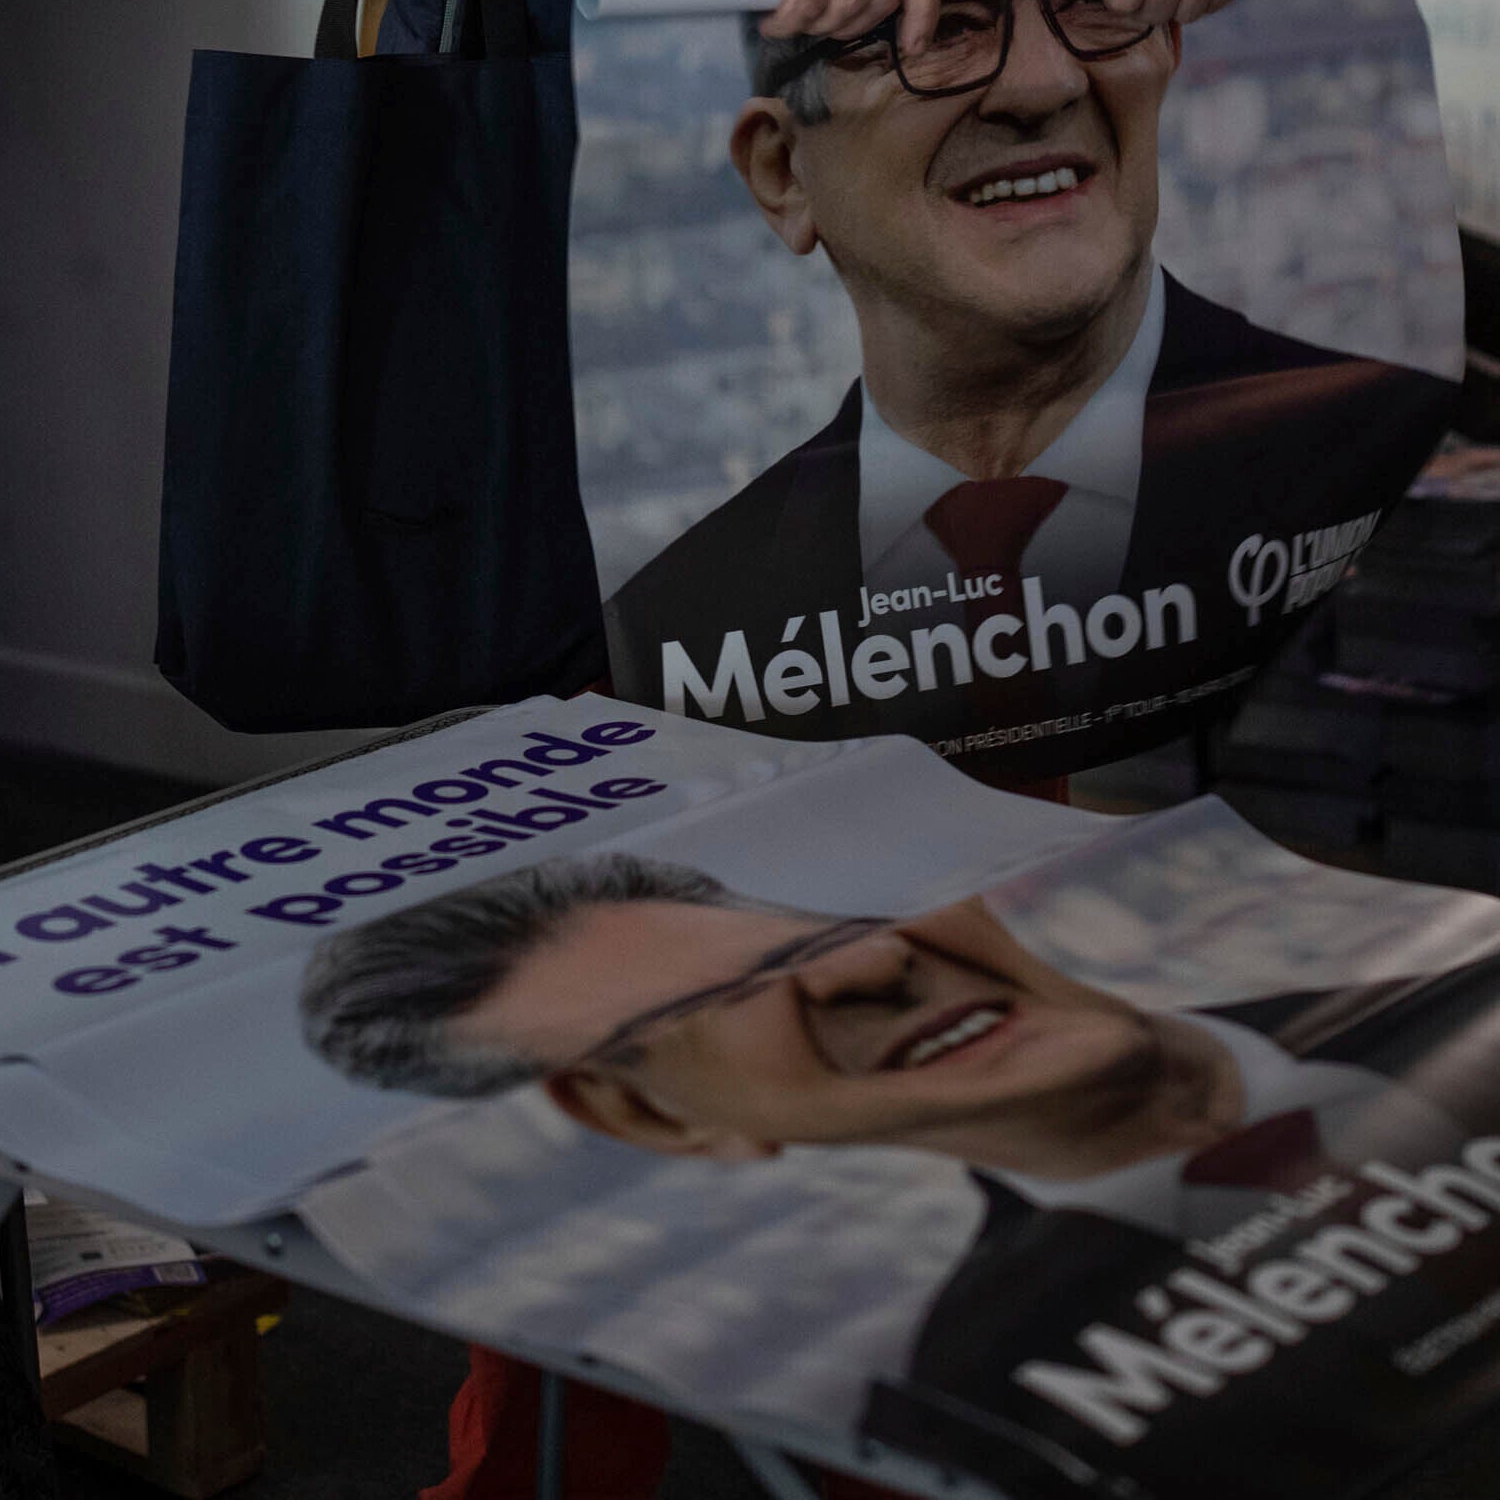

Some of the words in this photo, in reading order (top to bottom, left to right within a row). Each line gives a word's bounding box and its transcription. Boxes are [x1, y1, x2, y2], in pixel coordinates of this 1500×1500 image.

[660, 576, 1198, 726] Mélenchon
[858, 571, 1005, 628] Jean-Luc
[964, 711, 1093, 752] PRÉSIDENTIELLE
[14, 832, 324, 946] autre
[308, 718, 658, 842] monde
[49, 922, 241, 999] est
[244, 775, 670, 930] possible
